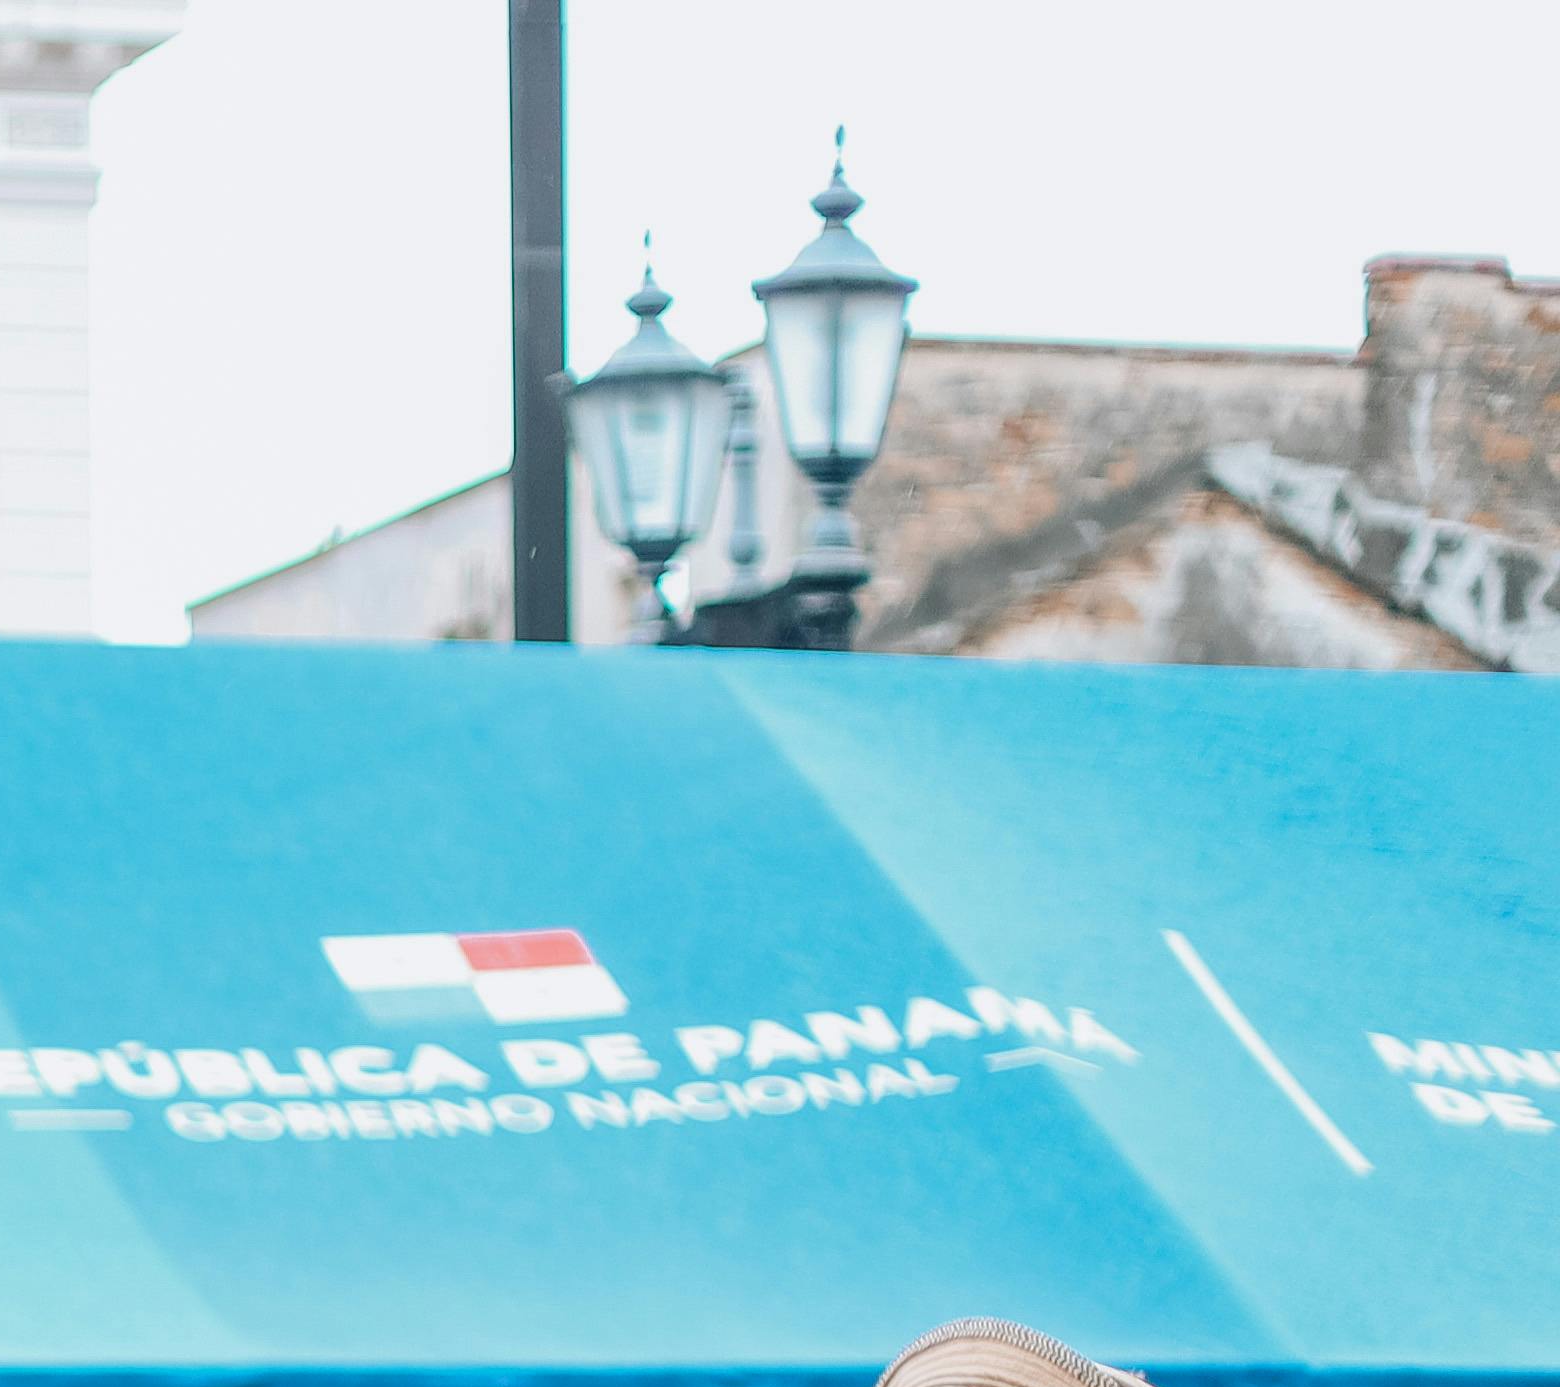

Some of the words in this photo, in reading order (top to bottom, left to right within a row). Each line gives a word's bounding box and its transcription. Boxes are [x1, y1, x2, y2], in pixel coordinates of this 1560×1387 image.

[500, 1033, 661, 1088] DE
[1363, 1030, 1560, 1089] MIN
[164, 1094, 555, 1142] GOBIERNO
[564, 1058, 961, 1131] NACIONAL
[1410, 1081, 1558, 1135] DE
